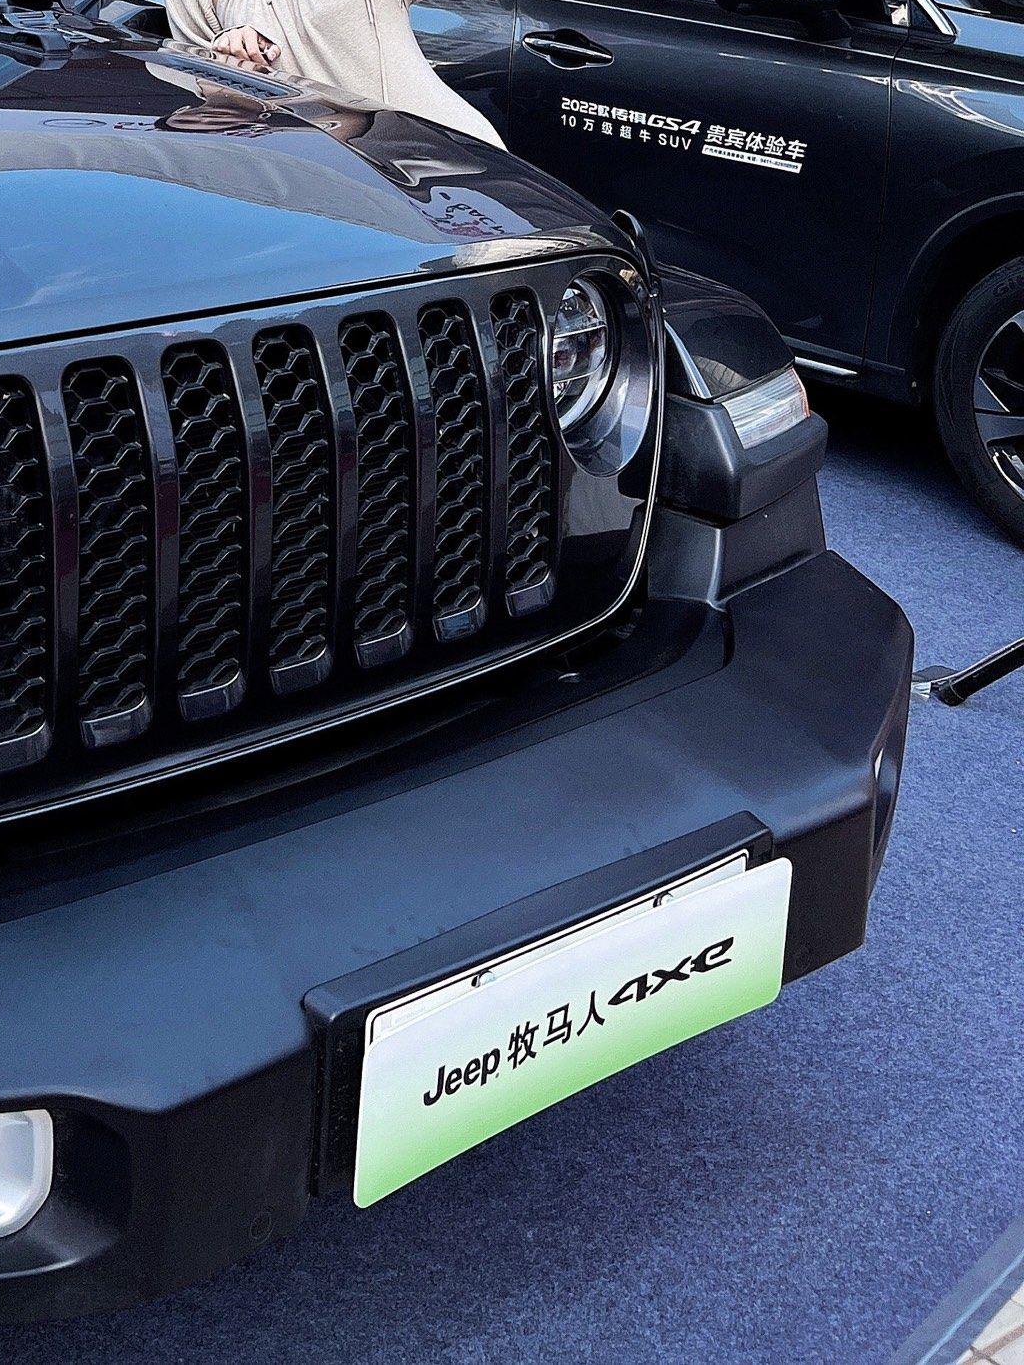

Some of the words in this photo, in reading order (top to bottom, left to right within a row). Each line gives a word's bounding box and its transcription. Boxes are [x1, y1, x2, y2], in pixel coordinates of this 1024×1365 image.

[705, 124, 808, 161] 贵宾体验车
[423, 1048, 501, 1107] Jeep
